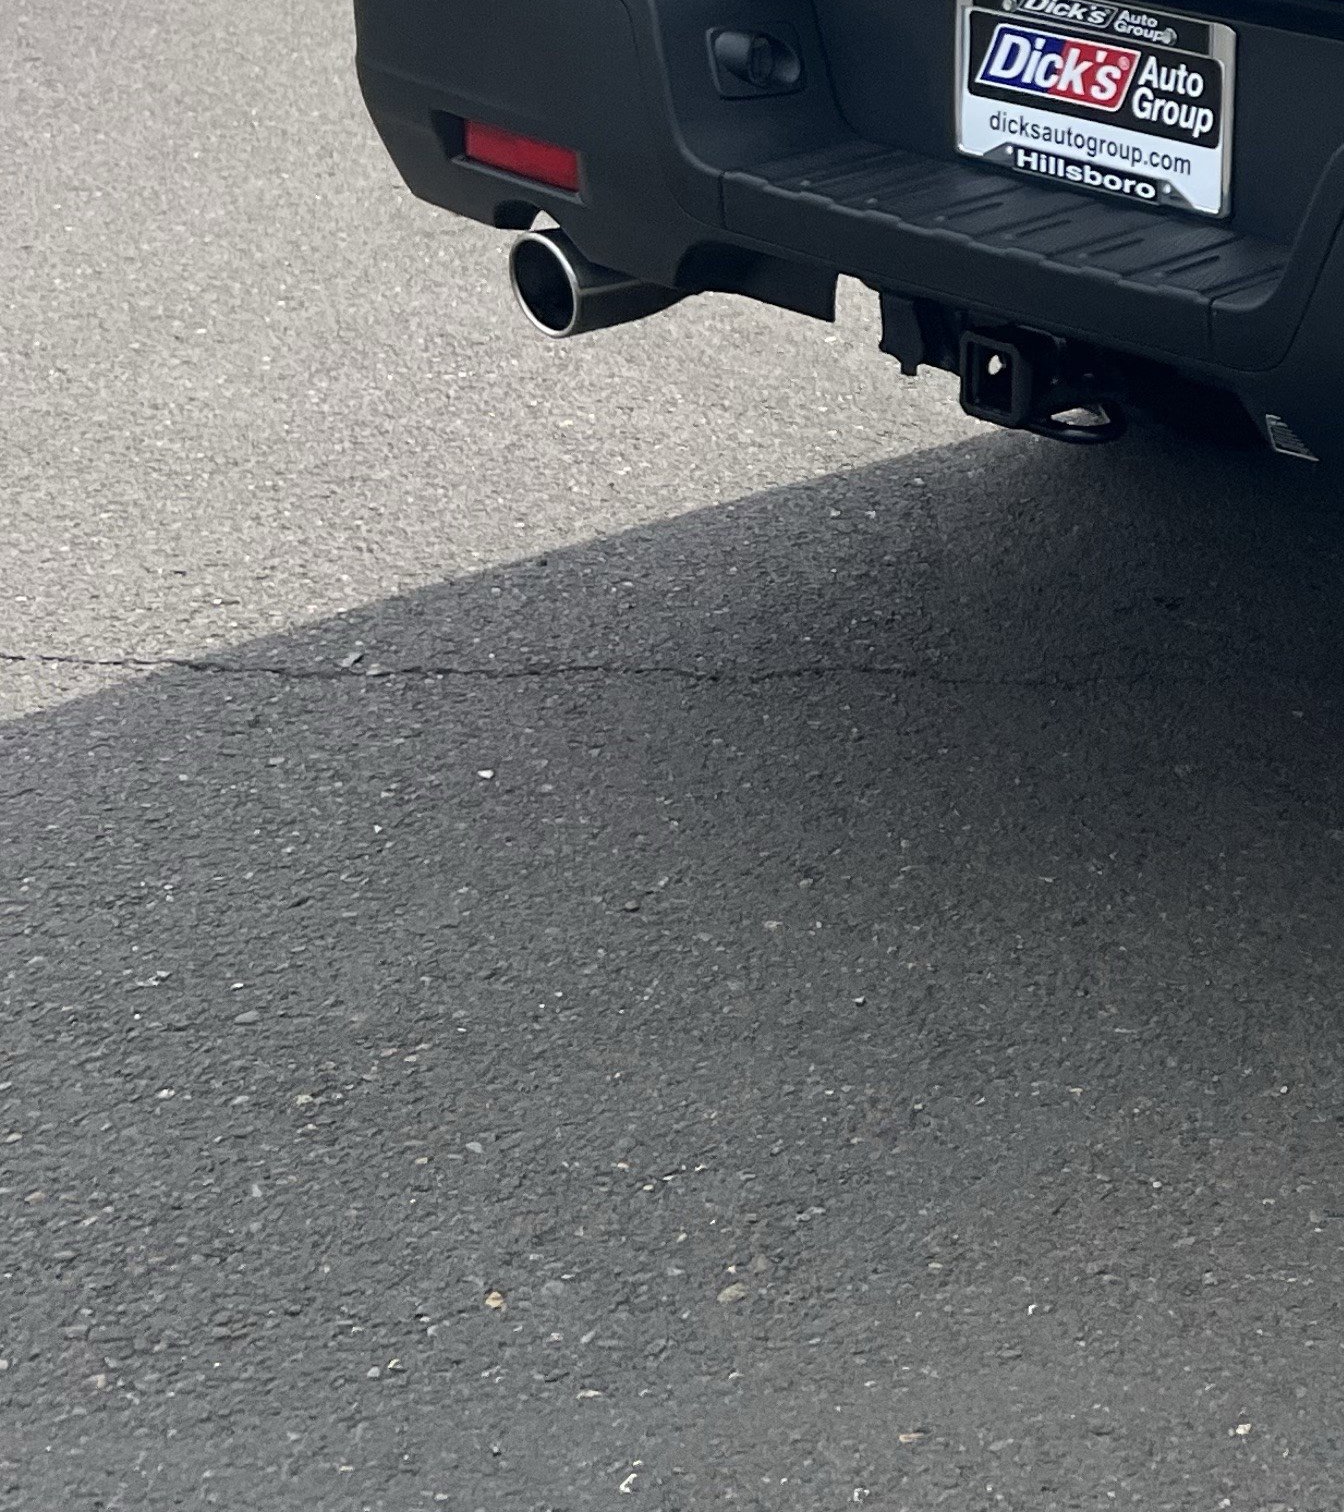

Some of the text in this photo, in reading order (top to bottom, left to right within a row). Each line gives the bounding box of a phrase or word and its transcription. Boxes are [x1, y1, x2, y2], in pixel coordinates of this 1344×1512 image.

[1116, 10, 1158, 28] Auto
[988, 33, 1122, 102] Dick's
[1138, 55, 1204, 97] Auto
[1131, 89, 1214, 138] Group
[989, 111, 1191, 175] dicksautogroup.com
[1016, 148, 1156, 199] Hillsboro
